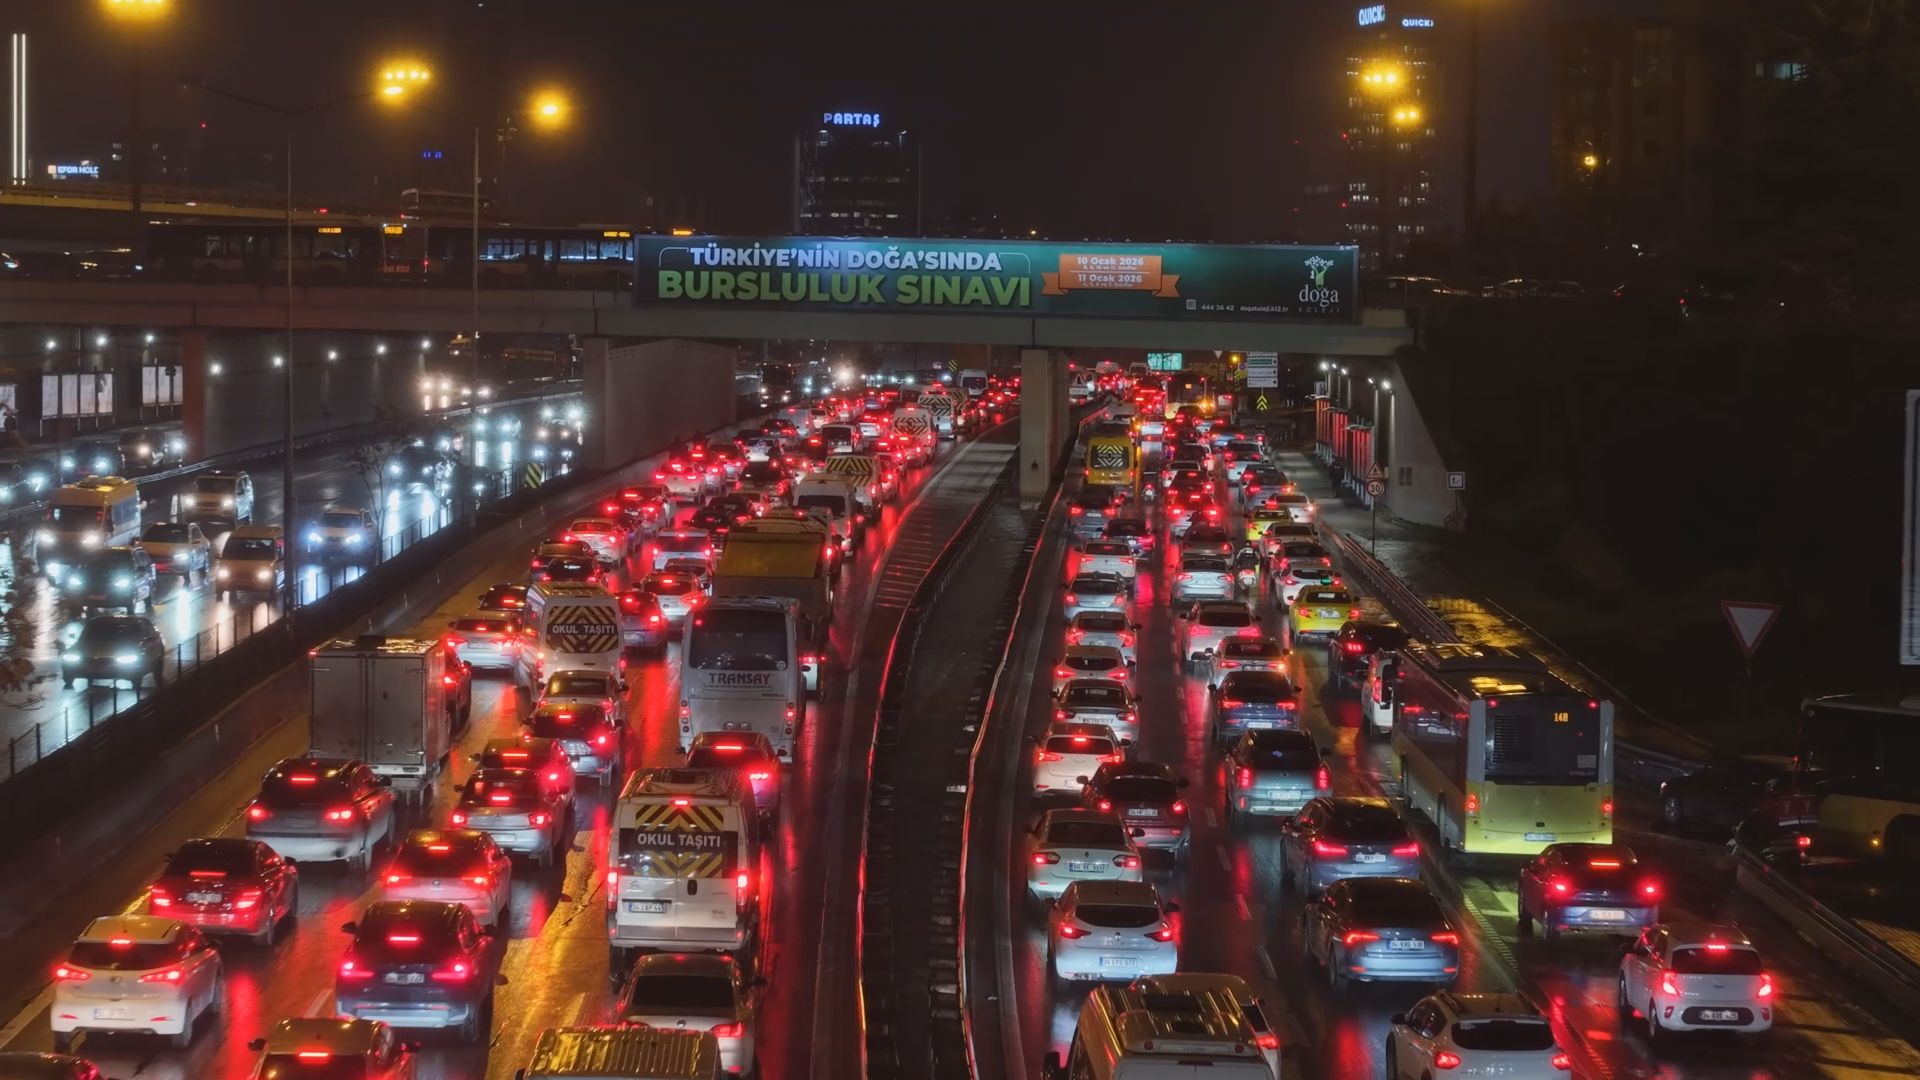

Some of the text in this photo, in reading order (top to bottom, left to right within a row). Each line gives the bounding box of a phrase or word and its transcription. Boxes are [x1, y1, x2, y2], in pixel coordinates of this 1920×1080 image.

[1359, 5, 1383, 26] QUICK
[1402, 19, 1430, 27] QUICK
[823, 112, 880, 128] PARTAŞ
[690, 242, 1002, 271] TÜRKİYE'NİN DOĞA'SINDA
[1077, 256, 1144, 266] 10 Ocak 2026
[1078, 273, 1143, 283] 11 Ocak 2026
[658, 270, 1031, 306] BURSLULUK SINAVI
[1299, 284, 1339, 308] doğa
[1370, 484, 1381, 493] 30
[552, 625, 615, 635] OKUL TAŞITI
[709, 672, 771, 685] TRANSAY
[637, 833, 721, 849] OKUL TAŞITI
